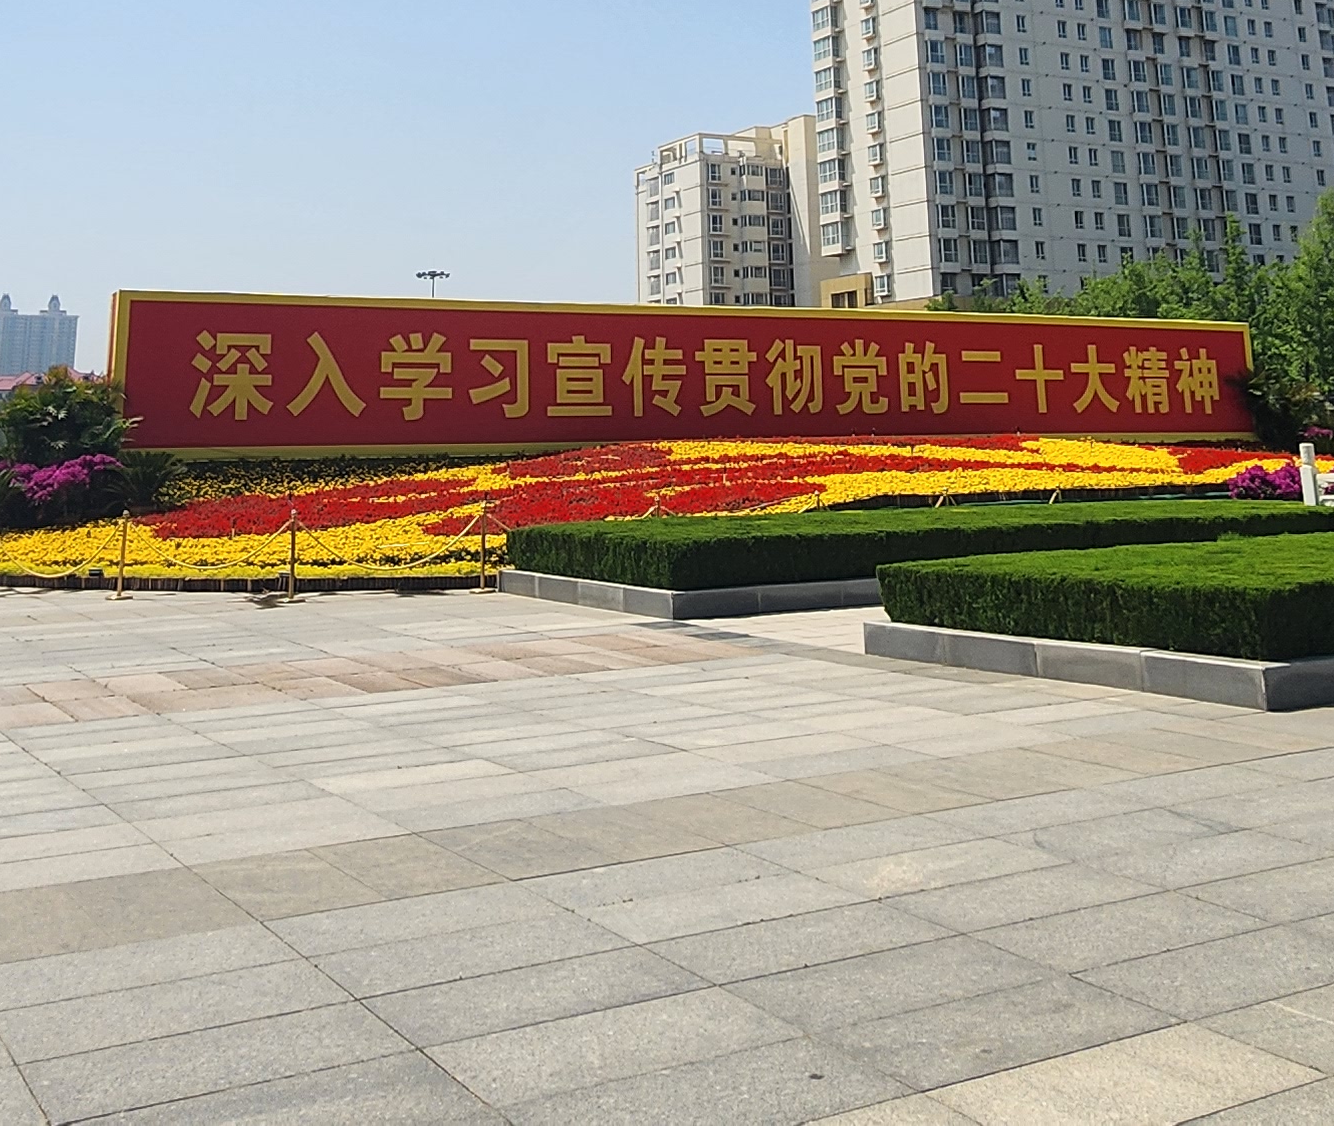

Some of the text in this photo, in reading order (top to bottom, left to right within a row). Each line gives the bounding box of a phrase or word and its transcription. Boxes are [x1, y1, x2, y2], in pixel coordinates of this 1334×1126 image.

[189, 330, 1221, 421] 深入学习宣传贯彻党的二十大精神
